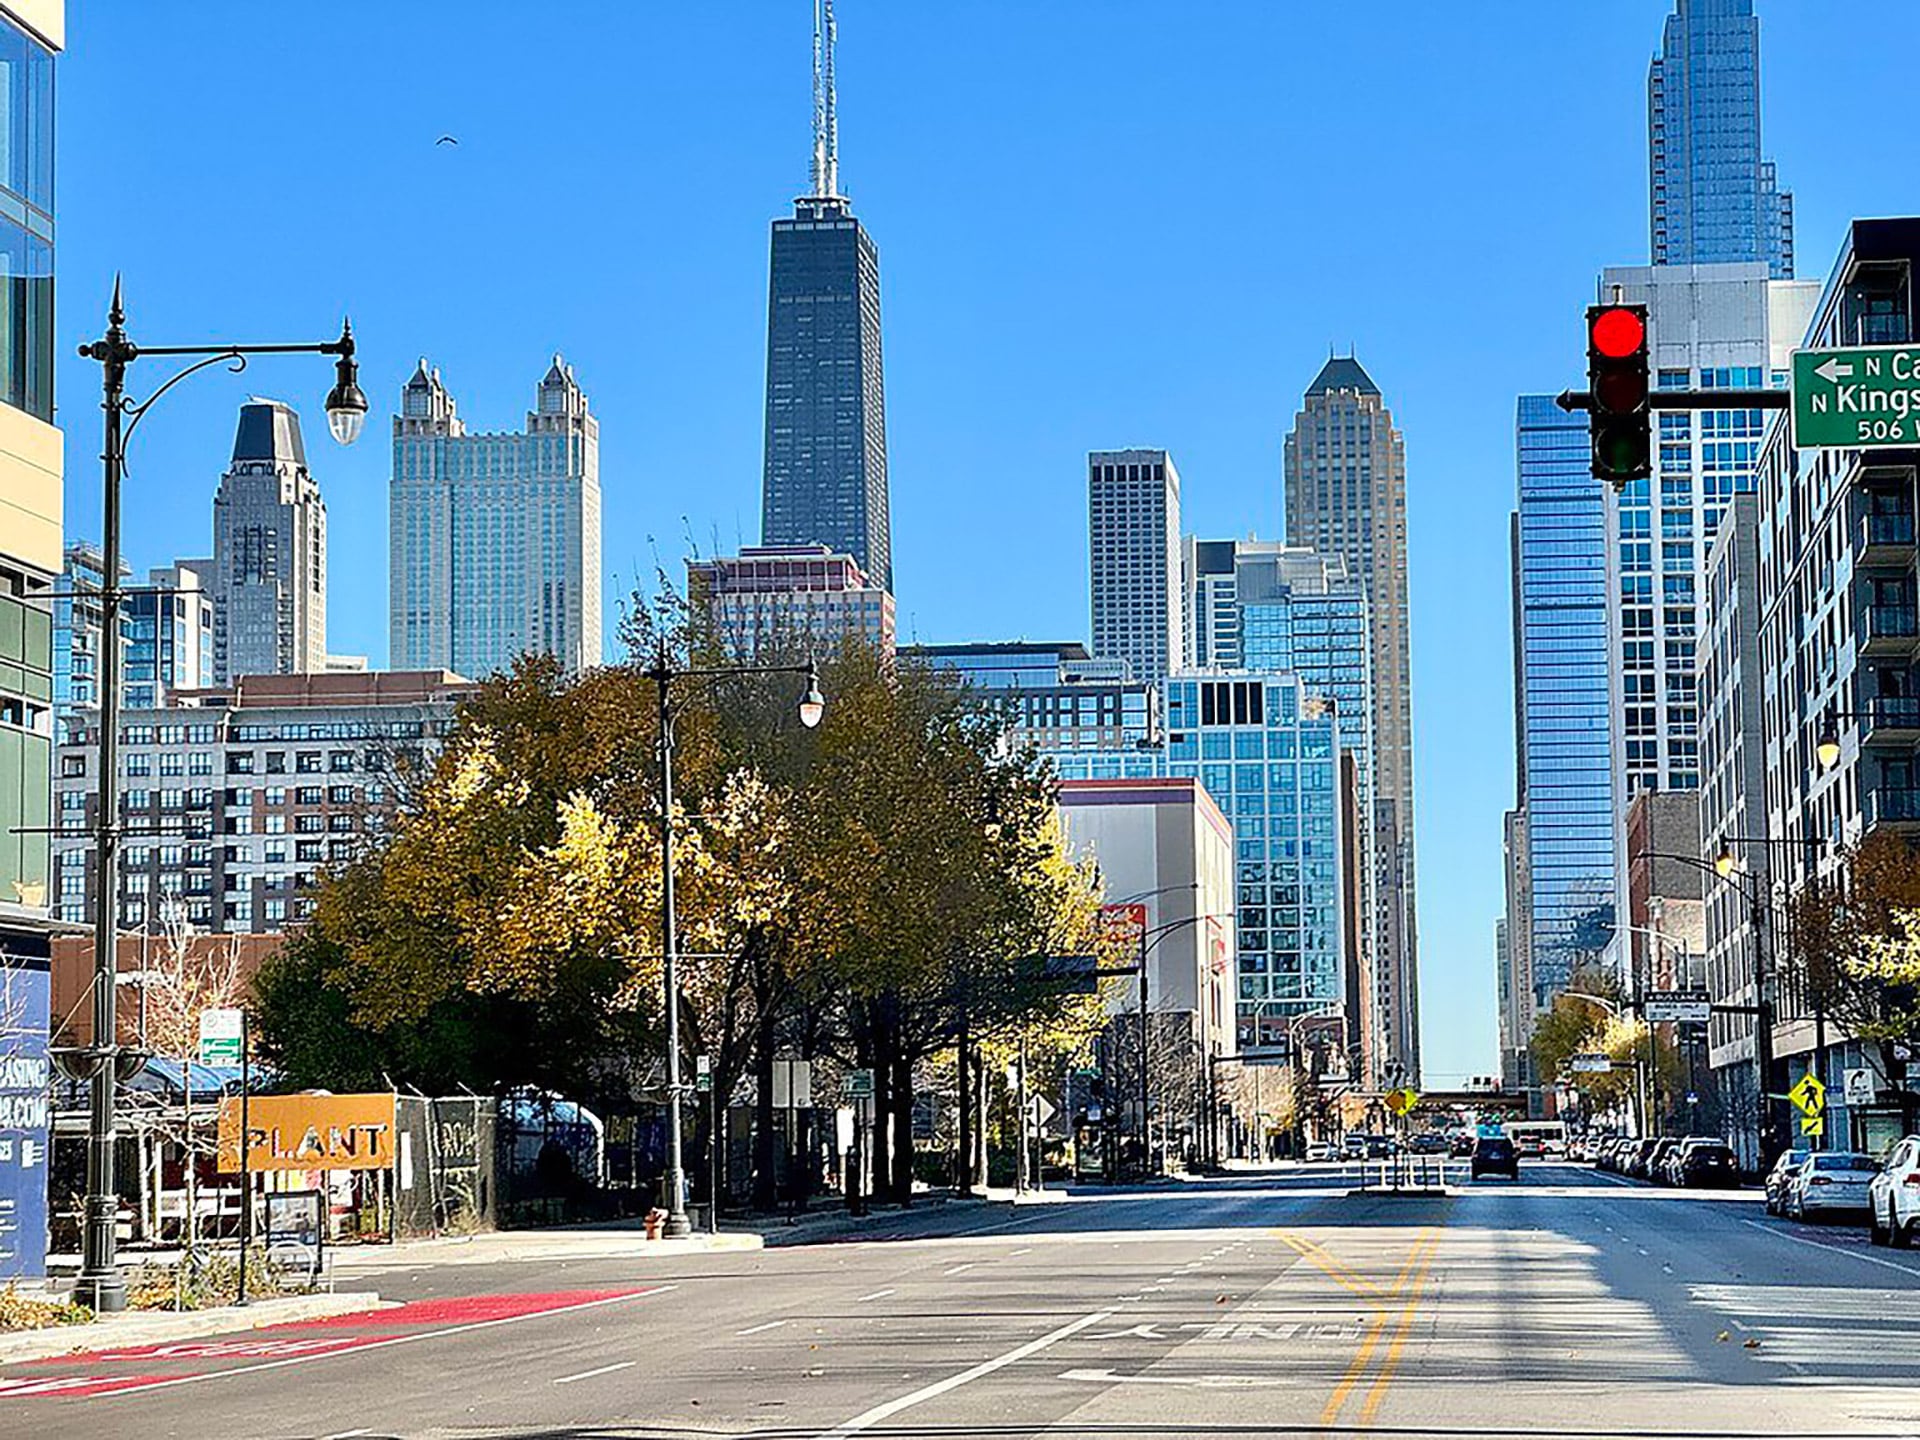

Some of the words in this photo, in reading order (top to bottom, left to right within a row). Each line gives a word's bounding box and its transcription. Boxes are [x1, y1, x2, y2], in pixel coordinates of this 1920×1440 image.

[1866, 357, 1880, 376] N
[1812, 394, 1827, 413] N
[1837, 384, 1920, 419] Kings
[1858, 420, 1903, 440] 506
[245, 1123, 387, 1159] PLANT
